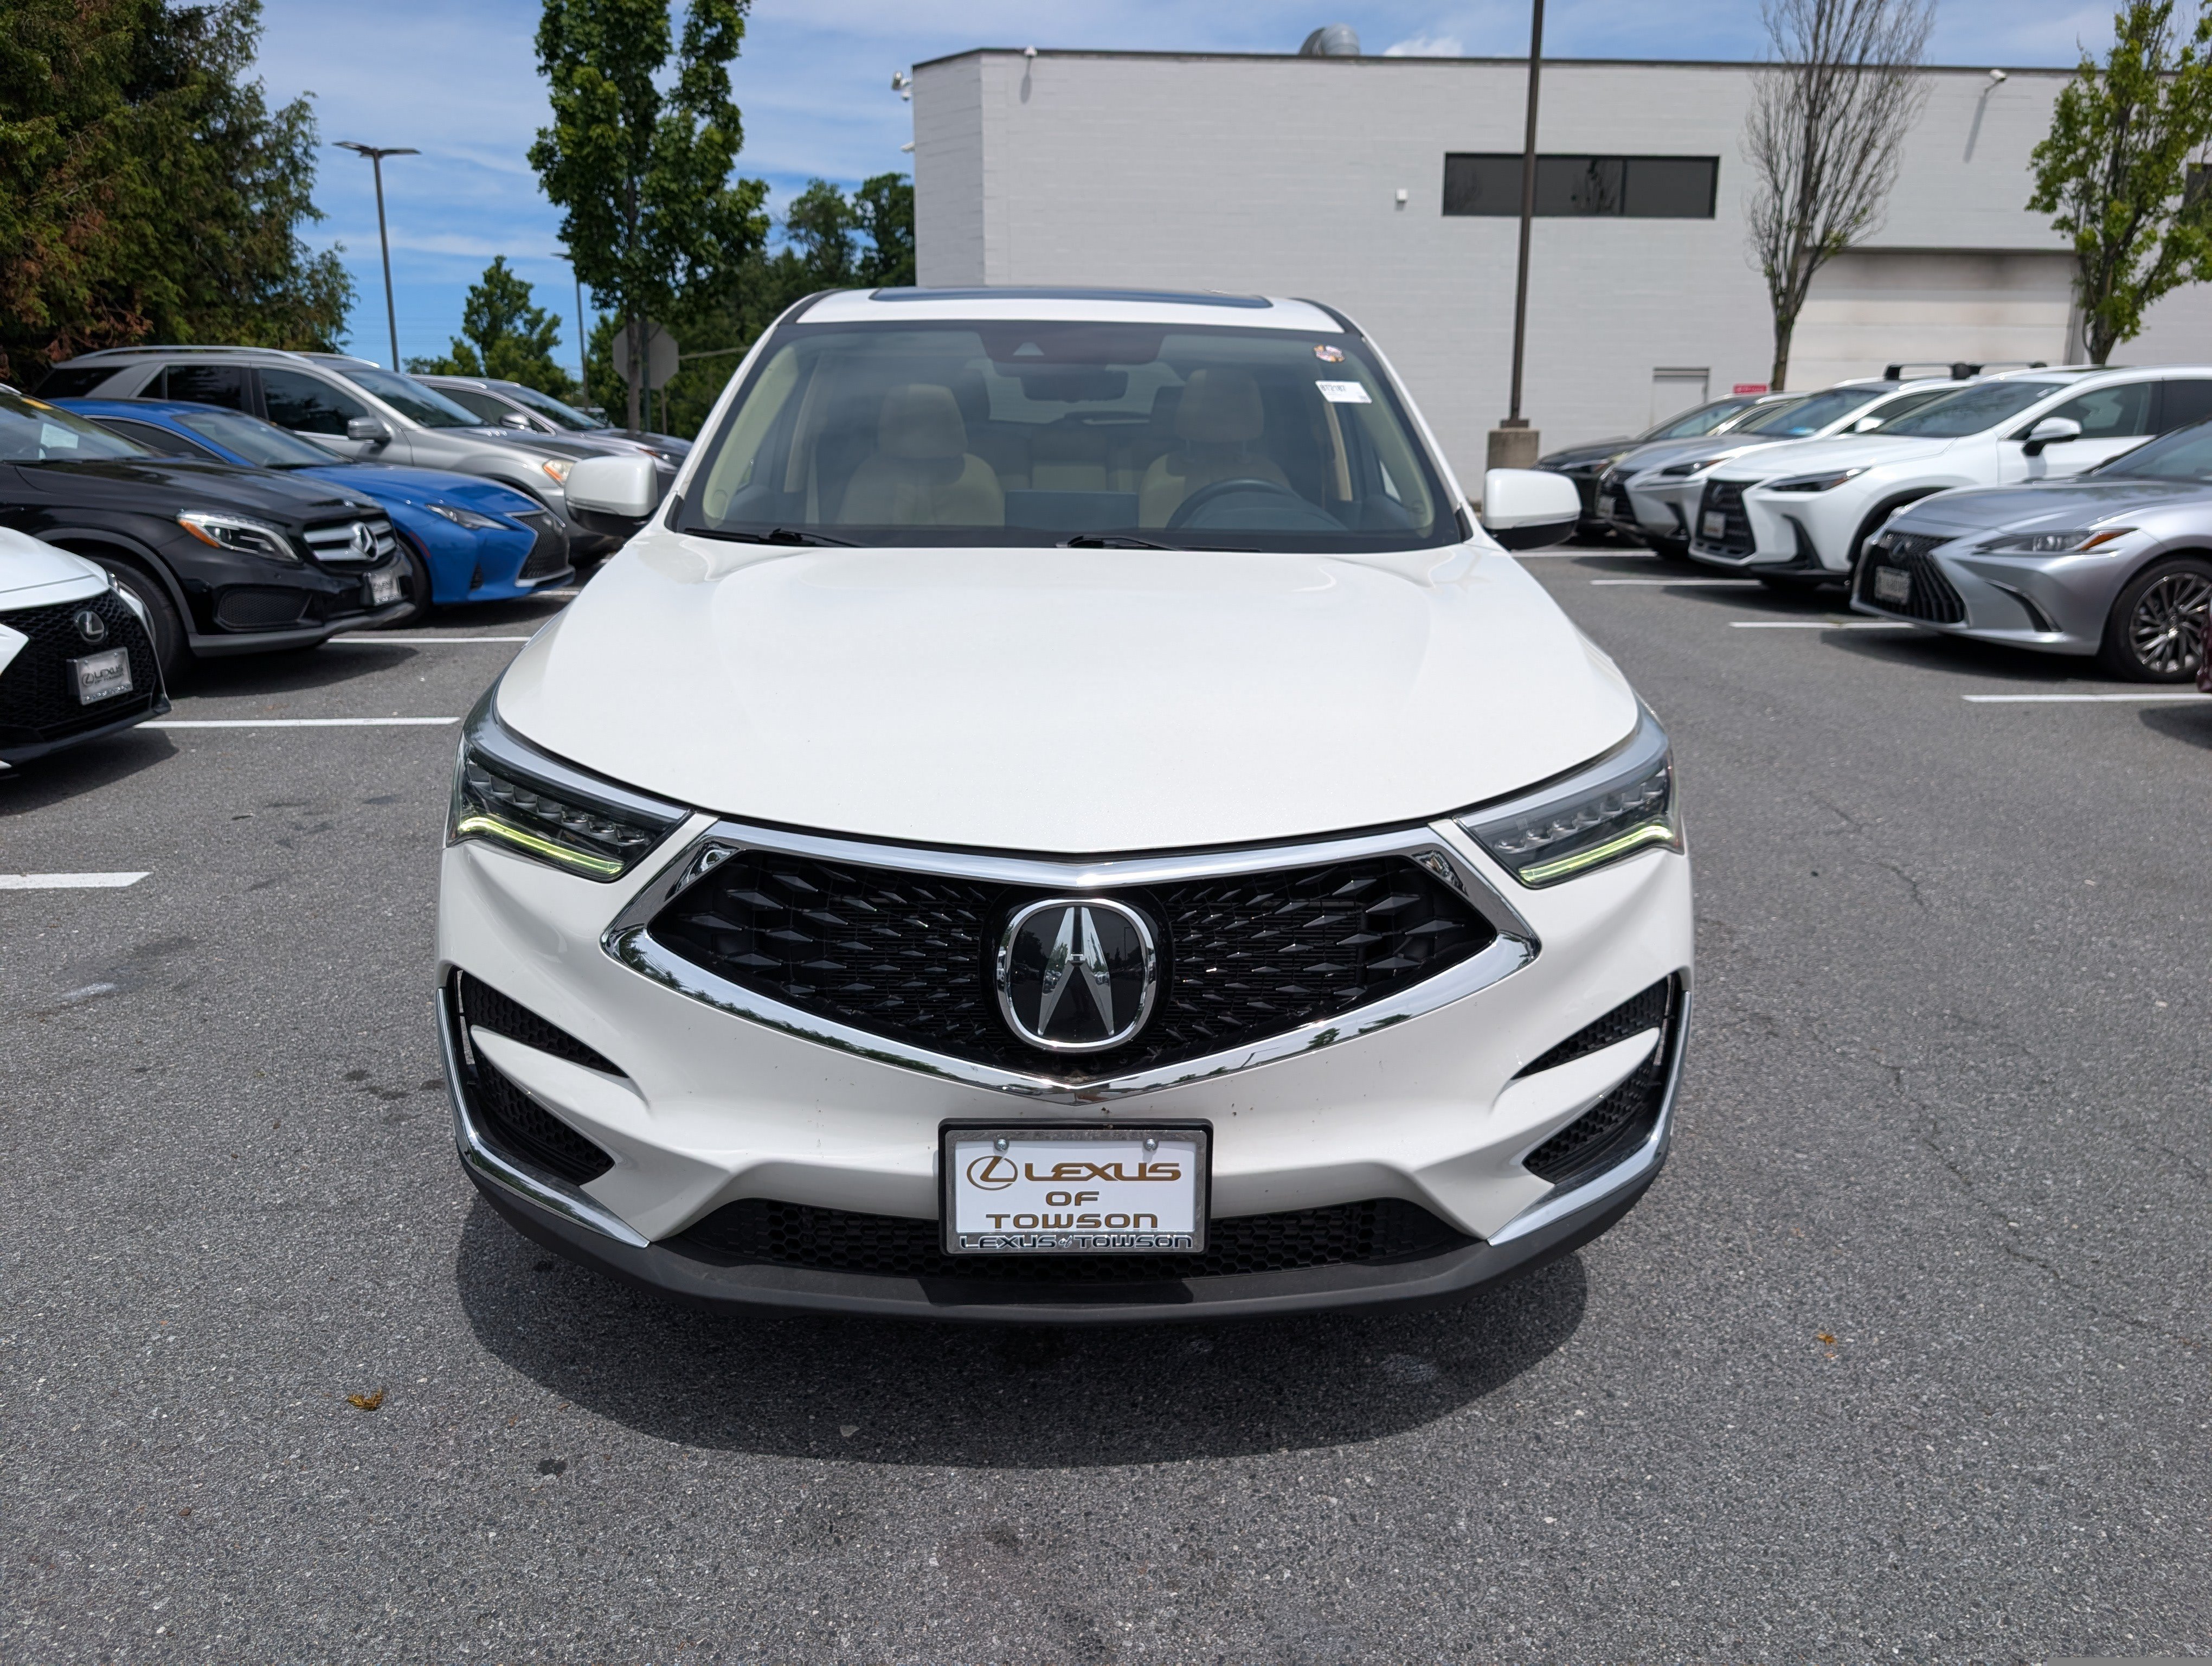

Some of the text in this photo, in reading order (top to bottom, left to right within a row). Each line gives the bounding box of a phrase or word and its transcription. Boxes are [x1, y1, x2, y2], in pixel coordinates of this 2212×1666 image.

[1025, 1162, 1181, 1181] LEXUS
[1045, 1191, 1099, 1206] OF
[986, 1213, 1158, 1228] TOWSON
[960, 1235, 1193, 1249] LEXUS of TOWSON
